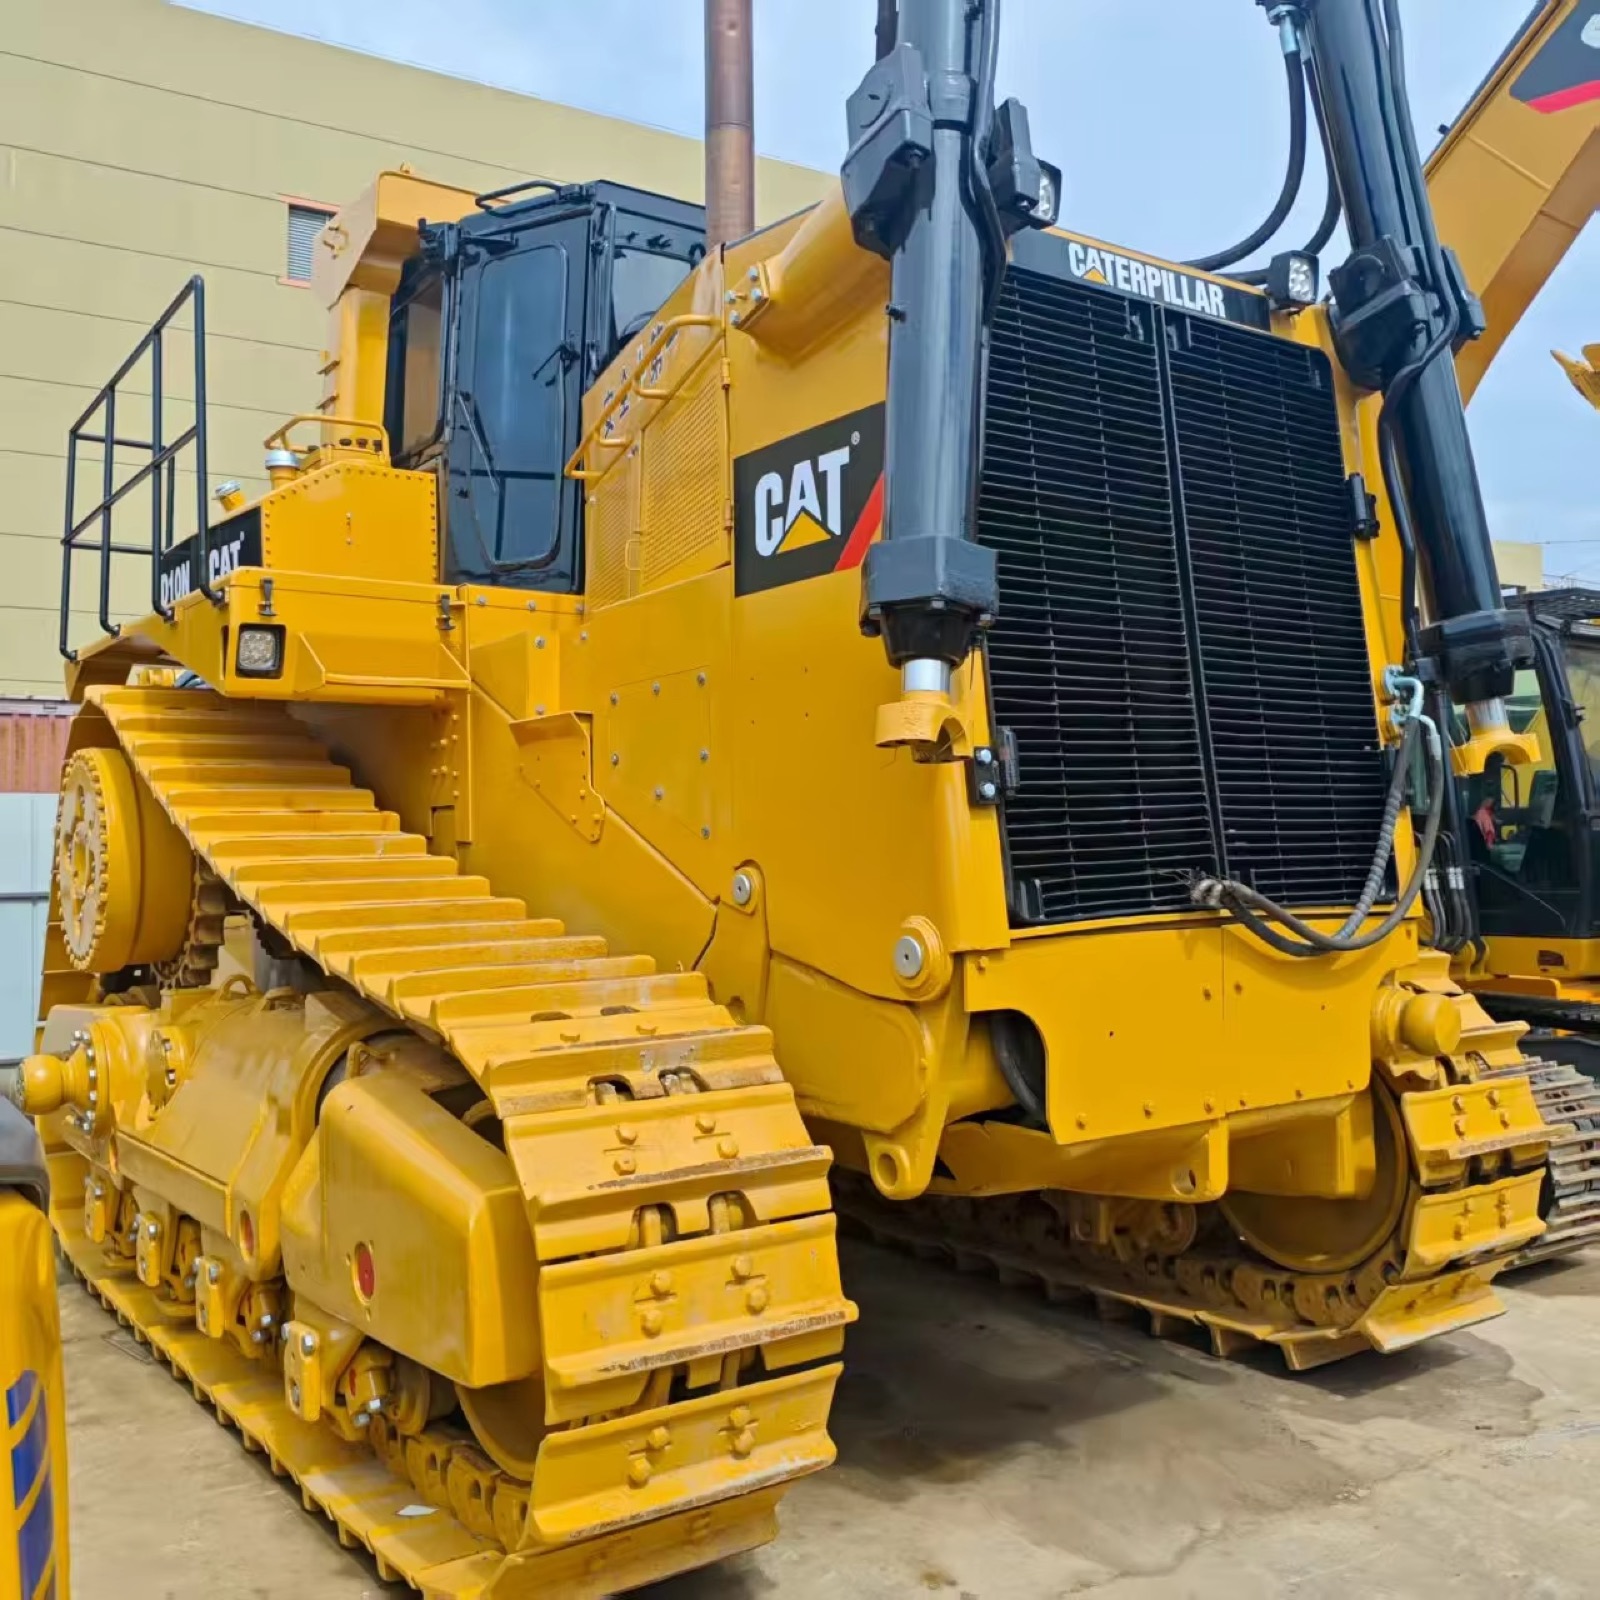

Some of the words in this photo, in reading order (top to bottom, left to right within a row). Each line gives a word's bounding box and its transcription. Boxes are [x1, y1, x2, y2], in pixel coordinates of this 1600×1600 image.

[1068, 242, 1226, 318] CATERPILLAR
[754, 444, 850, 557] CAT
[209, 540, 241, 582] CAT
